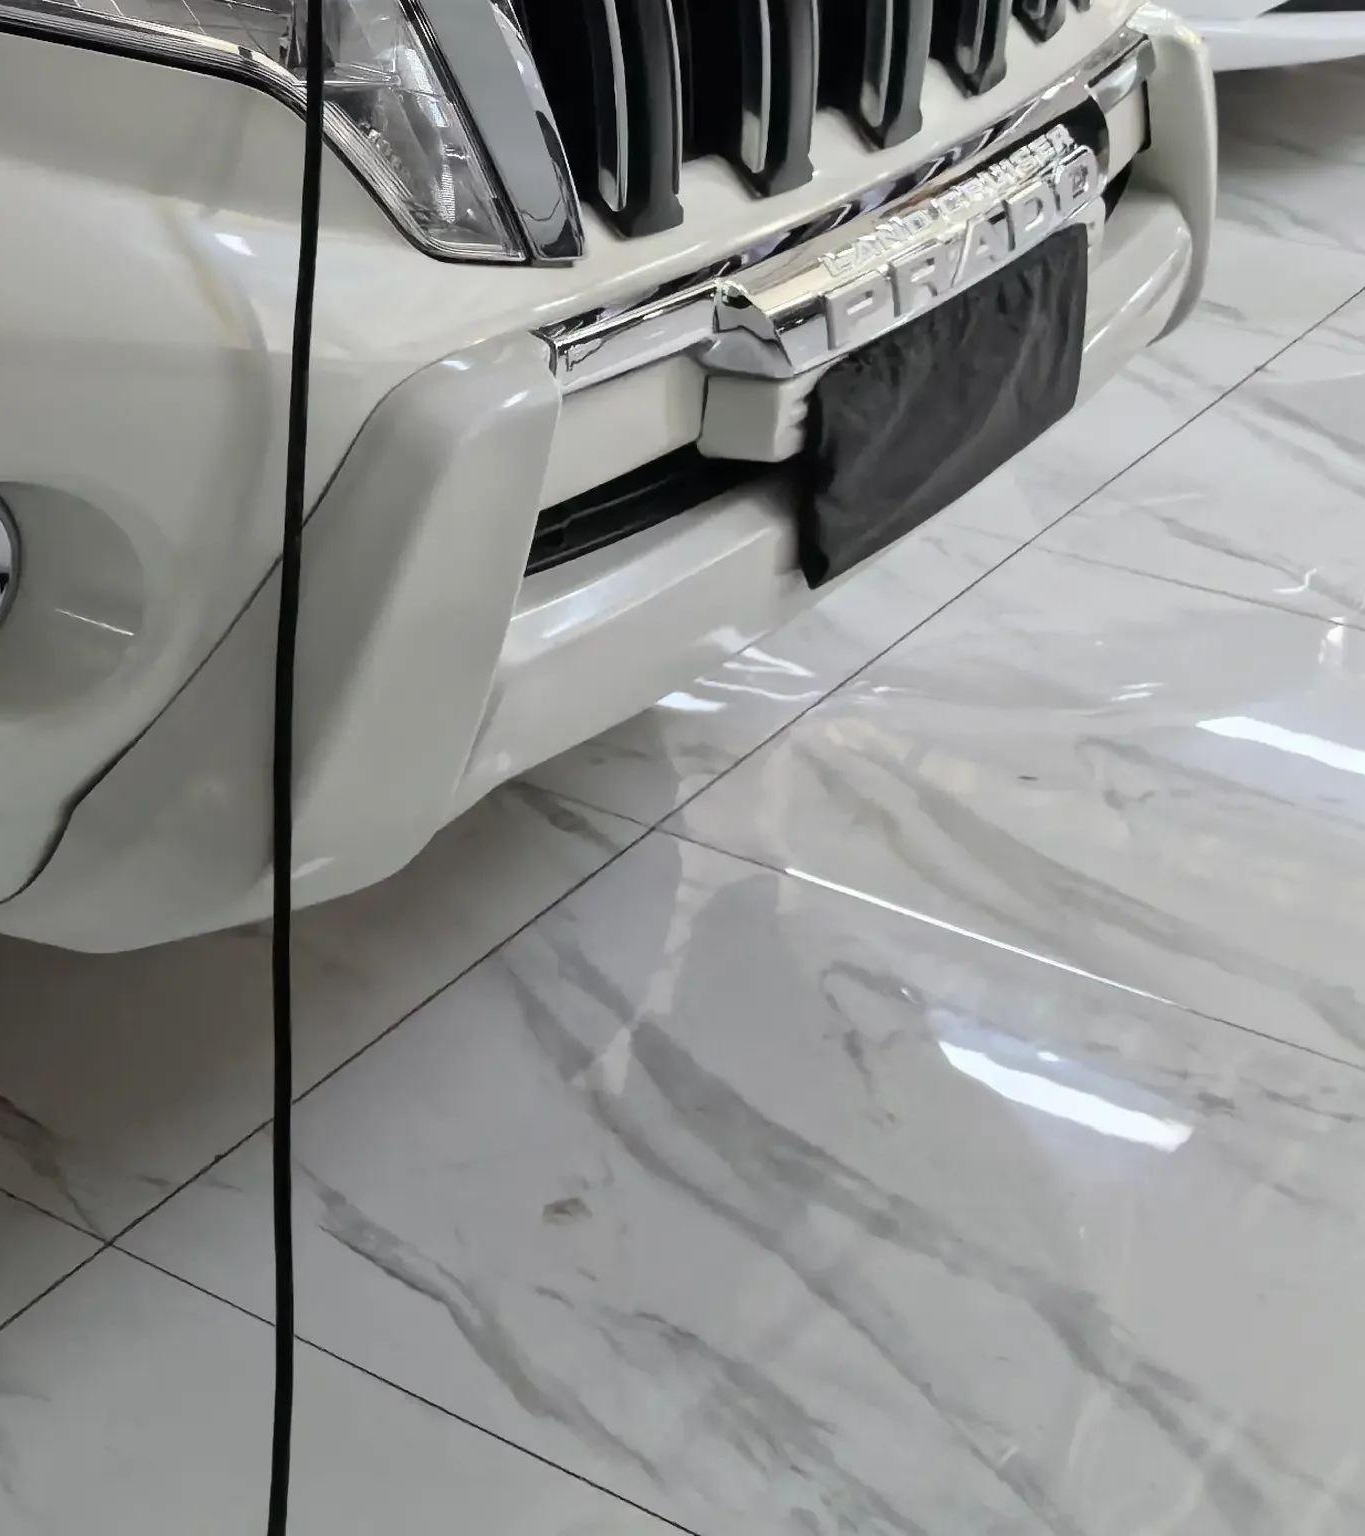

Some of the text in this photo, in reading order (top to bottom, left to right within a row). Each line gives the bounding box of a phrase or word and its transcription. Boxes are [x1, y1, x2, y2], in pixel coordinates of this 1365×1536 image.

[818, 123, 1077, 277] LAND CRUISER
[824, 145, 1099, 351] PRADO
